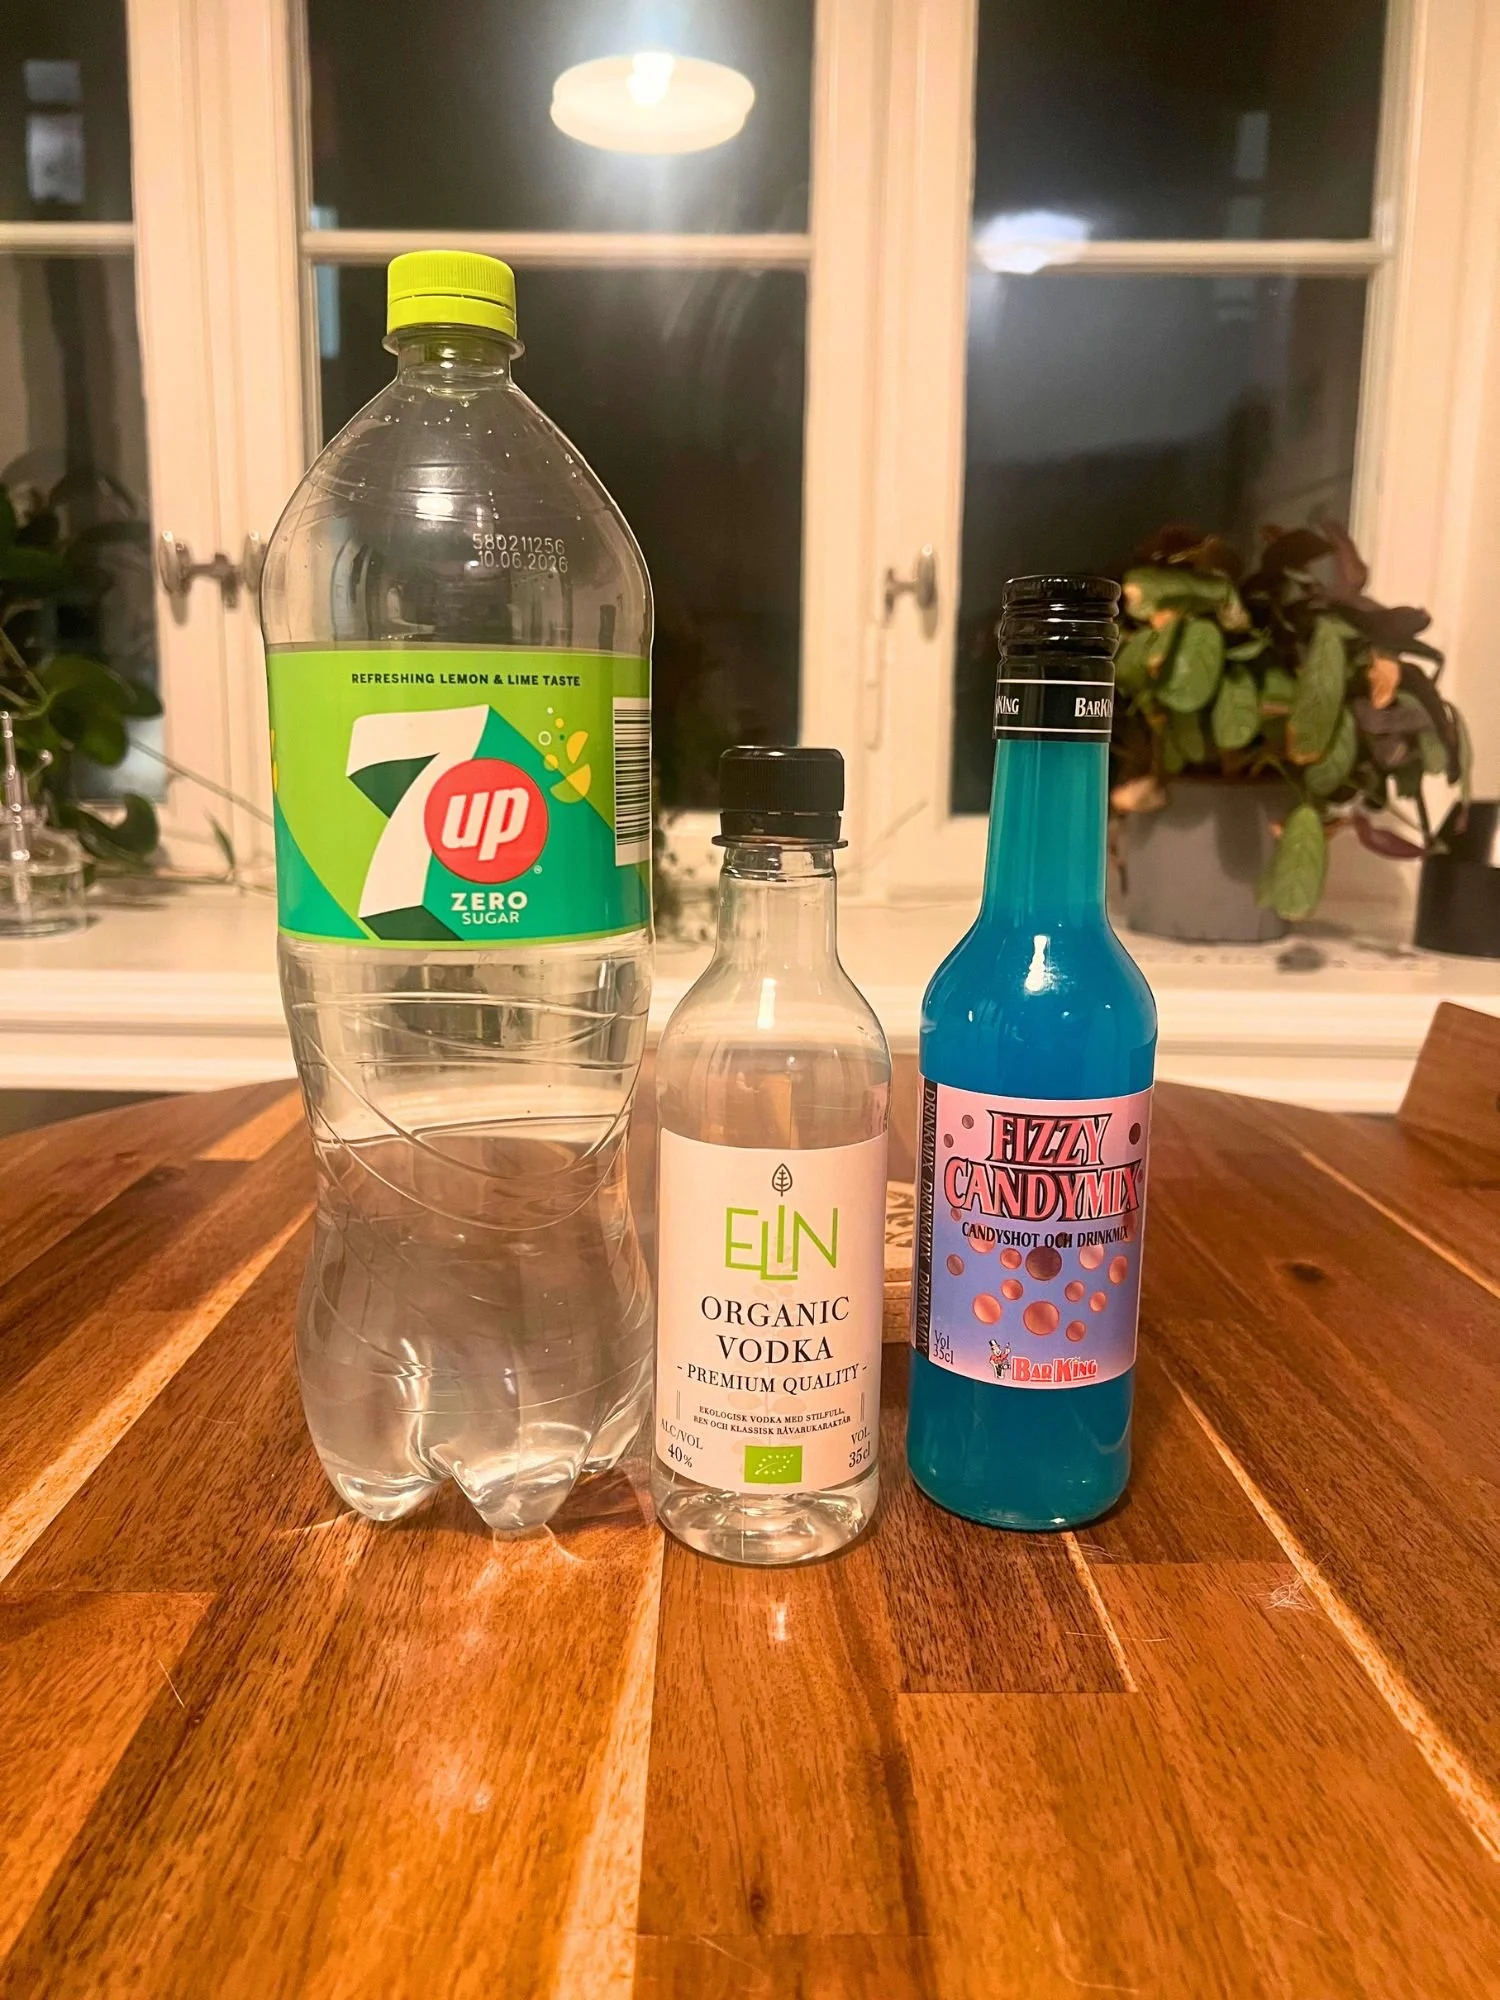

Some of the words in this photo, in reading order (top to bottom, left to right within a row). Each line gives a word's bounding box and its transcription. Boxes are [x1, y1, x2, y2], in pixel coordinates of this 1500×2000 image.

[472, 533, 565, 555] 580211256
[478, 550, 568, 573] 10.06.2026
[352, 673, 434, 684] REFRESHING
[440, 674, 488, 684] LEMON
[494, 674, 503, 684] &
[508, 675, 538, 685] LIME
[543, 675, 581, 686] TASTE
[451, 891, 528, 911] ZERO
[462, 911, 520, 925] SUGAR
[923, 1088, 936, 1172] DRINKMIX
[986, 1109, 1112, 1166] FIZZY
[944, 1157, 1142, 1221] CANDYMIX
[921, 1179, 933, 1262] DRINKMIX
[725, 1205, 838, 1281] ELIN
[962, 1222, 1040, 1248] CANDYSHOT
[1045, 1232, 1073, 1248] OCH
[1077, 1225, 1129, 1247] DRINKMIX
[701, 1296, 850, 1328] ORGANIC
[918, 1268, 930, 1352] DRINKMIX
[716, 1335, 834, 1364] VODKA
[934, 1329, 950, 1350] Vol
[933, 1344, 955, 1365] 35cl
[688, 1363, 775, 1393] PREMIUM
[783, 1363, 860, 1396] QUALITY
[693, 1415, 708, 1426] REN
[710, 1420, 728, 1431] OCH
[730, 1424, 774, 1435] KLASSISK
[699, 1405, 747, 1423] EKOLOGISK
[750, 1416, 782, 1424] VODKA
[784, 1415, 804, 1424] MED
[668, 1443, 693, 1468] 40%
[848, 1441, 871, 1468] 35cl
